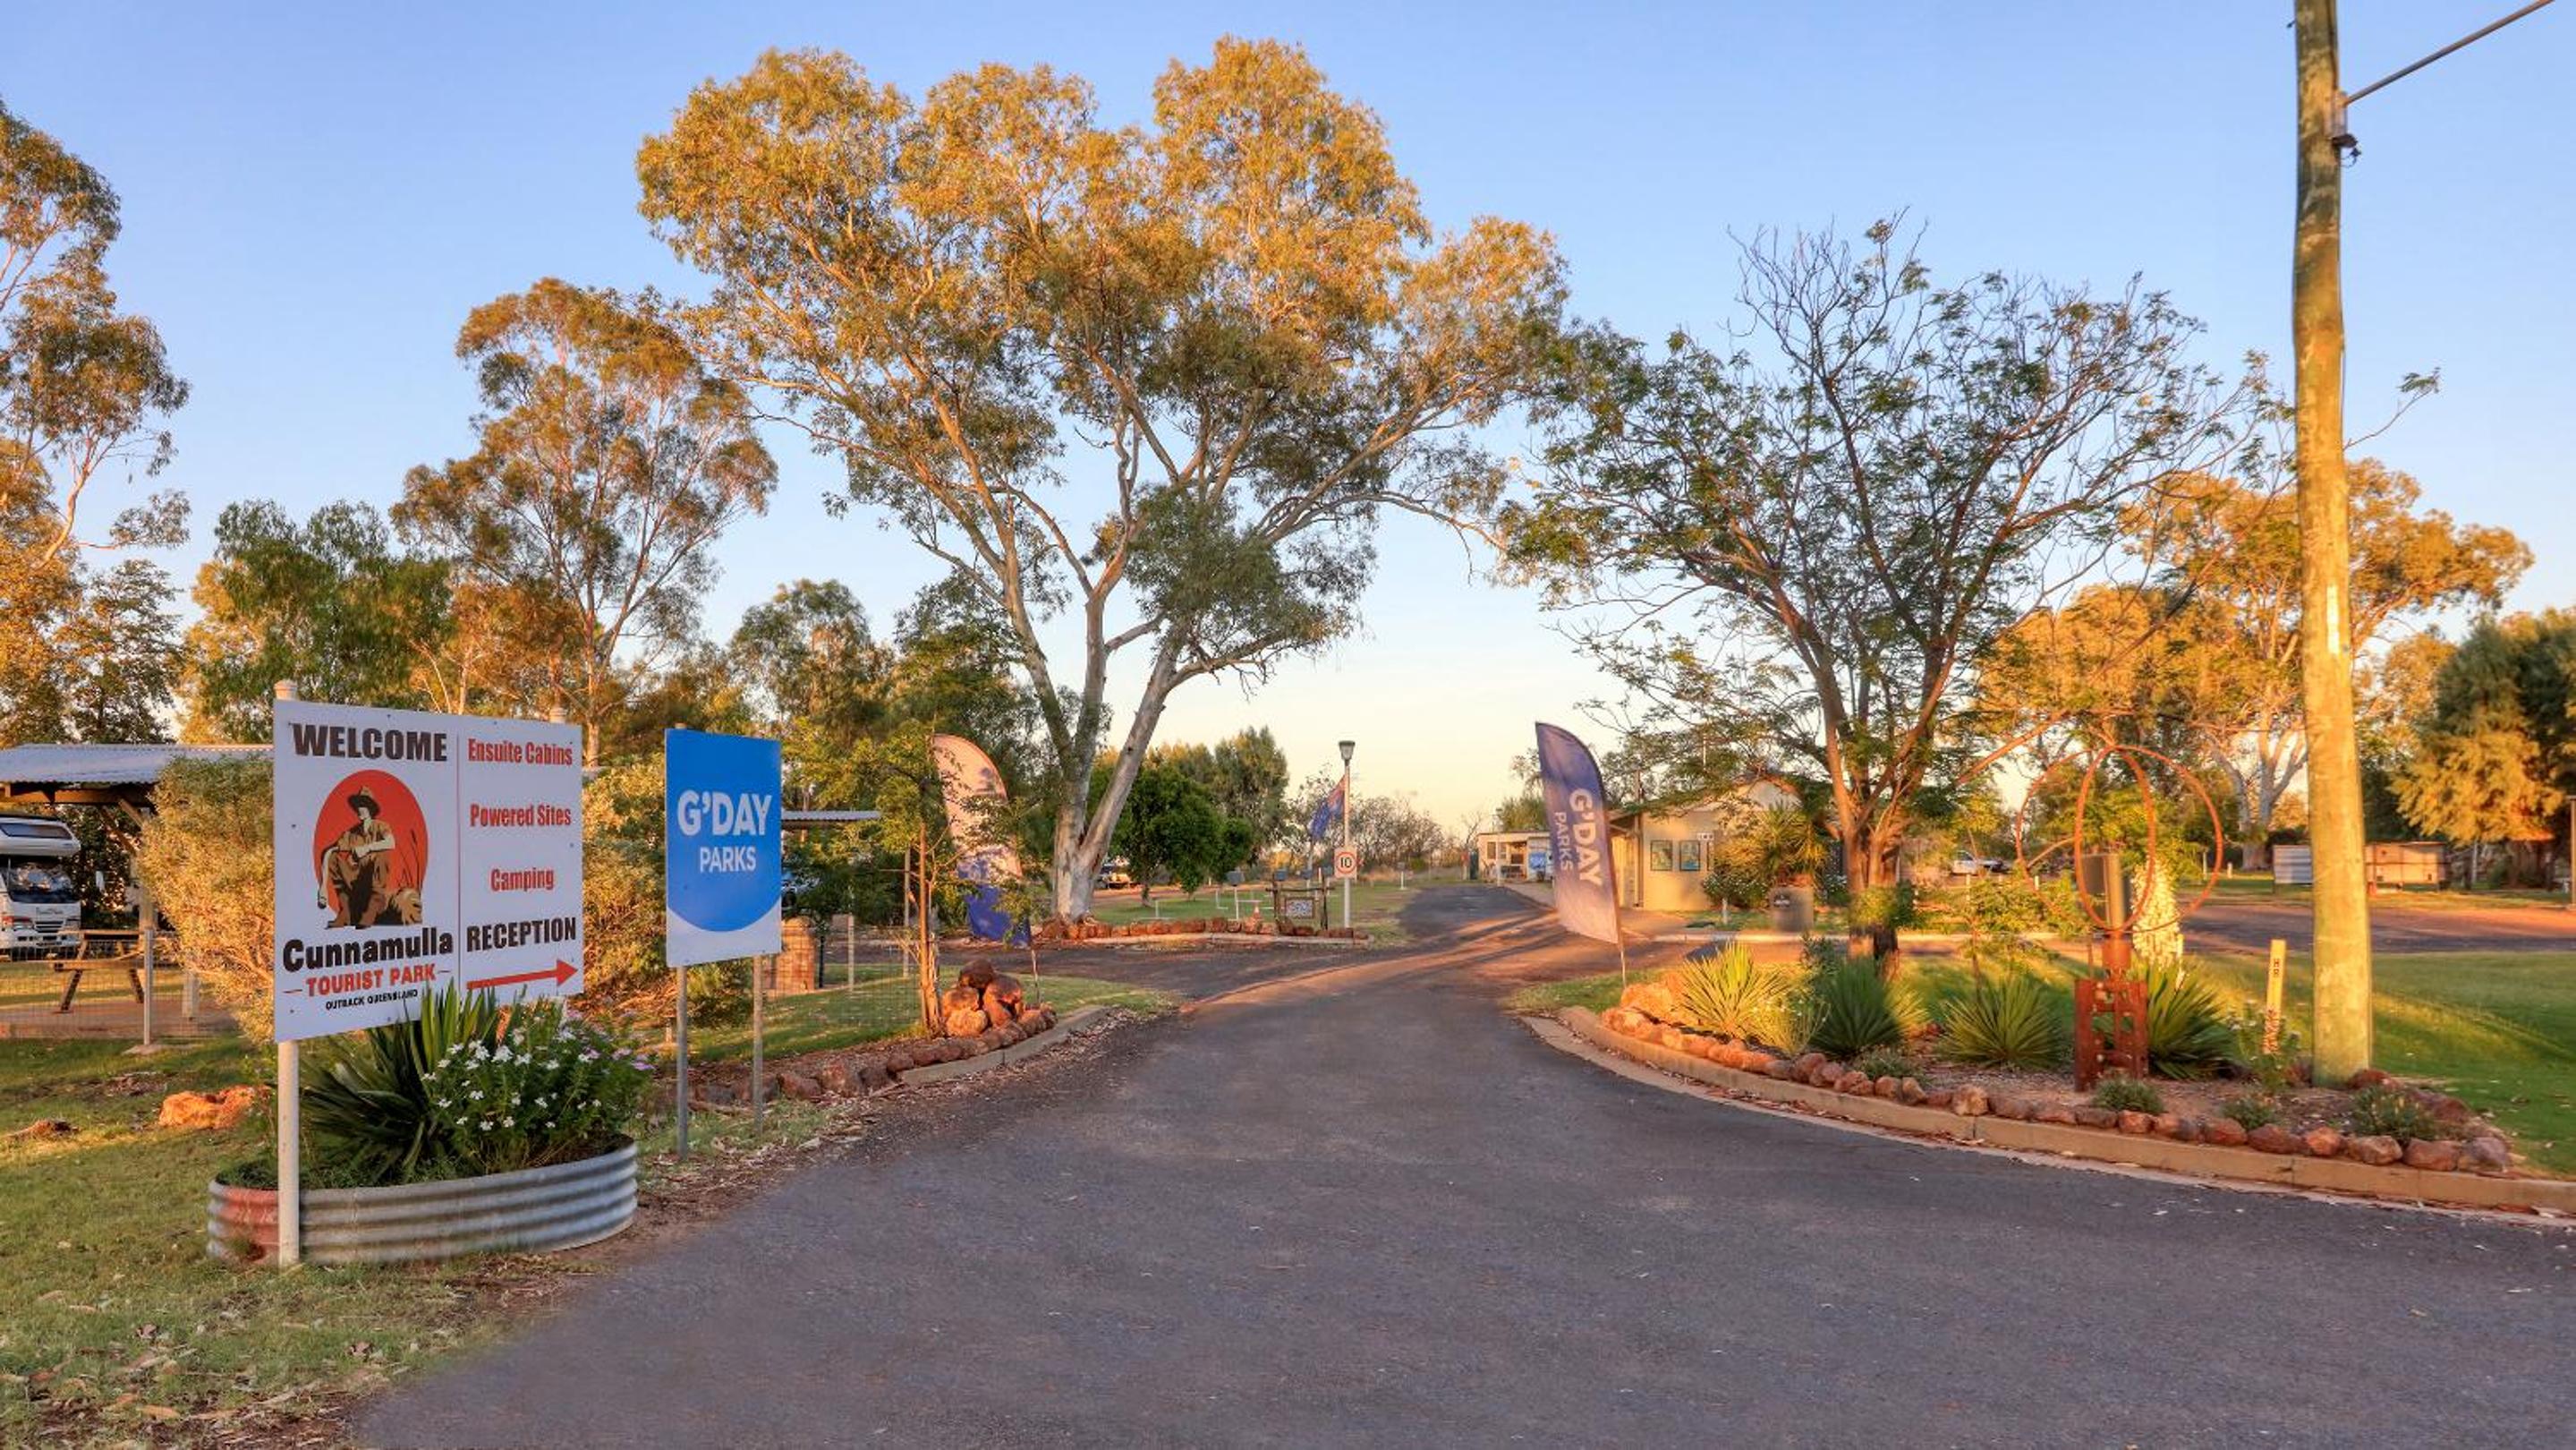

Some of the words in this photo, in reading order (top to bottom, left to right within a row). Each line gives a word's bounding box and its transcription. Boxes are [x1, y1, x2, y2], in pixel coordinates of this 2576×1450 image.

[293, 724, 447, 761] WELCOME
[468, 738, 523, 763] Ensuite
[525, 741, 573, 765] Cabins
[470, 804, 534, 827] Powered
[537, 805, 571, 825] Sites
[677, 789, 773, 837] G'DAY
[1554, 812, 1573, 870] PARKS
[1569, 789, 1603, 885] G'DAY
[700, 845, 757, 874] PARKS
[1340, 857, 1352, 868] 10
[490, 866, 555, 892] Camping
[283, 927, 453, 972] Cunnamulla
[466, 917, 577, 951] RECEPTION
[306, 968, 384, 997] TOURIST
[390, 963, 436, 985] PARK
[325, 994, 364, 1011] OUTBACK
[367, 988, 419, 1004] QUEENSLAND
